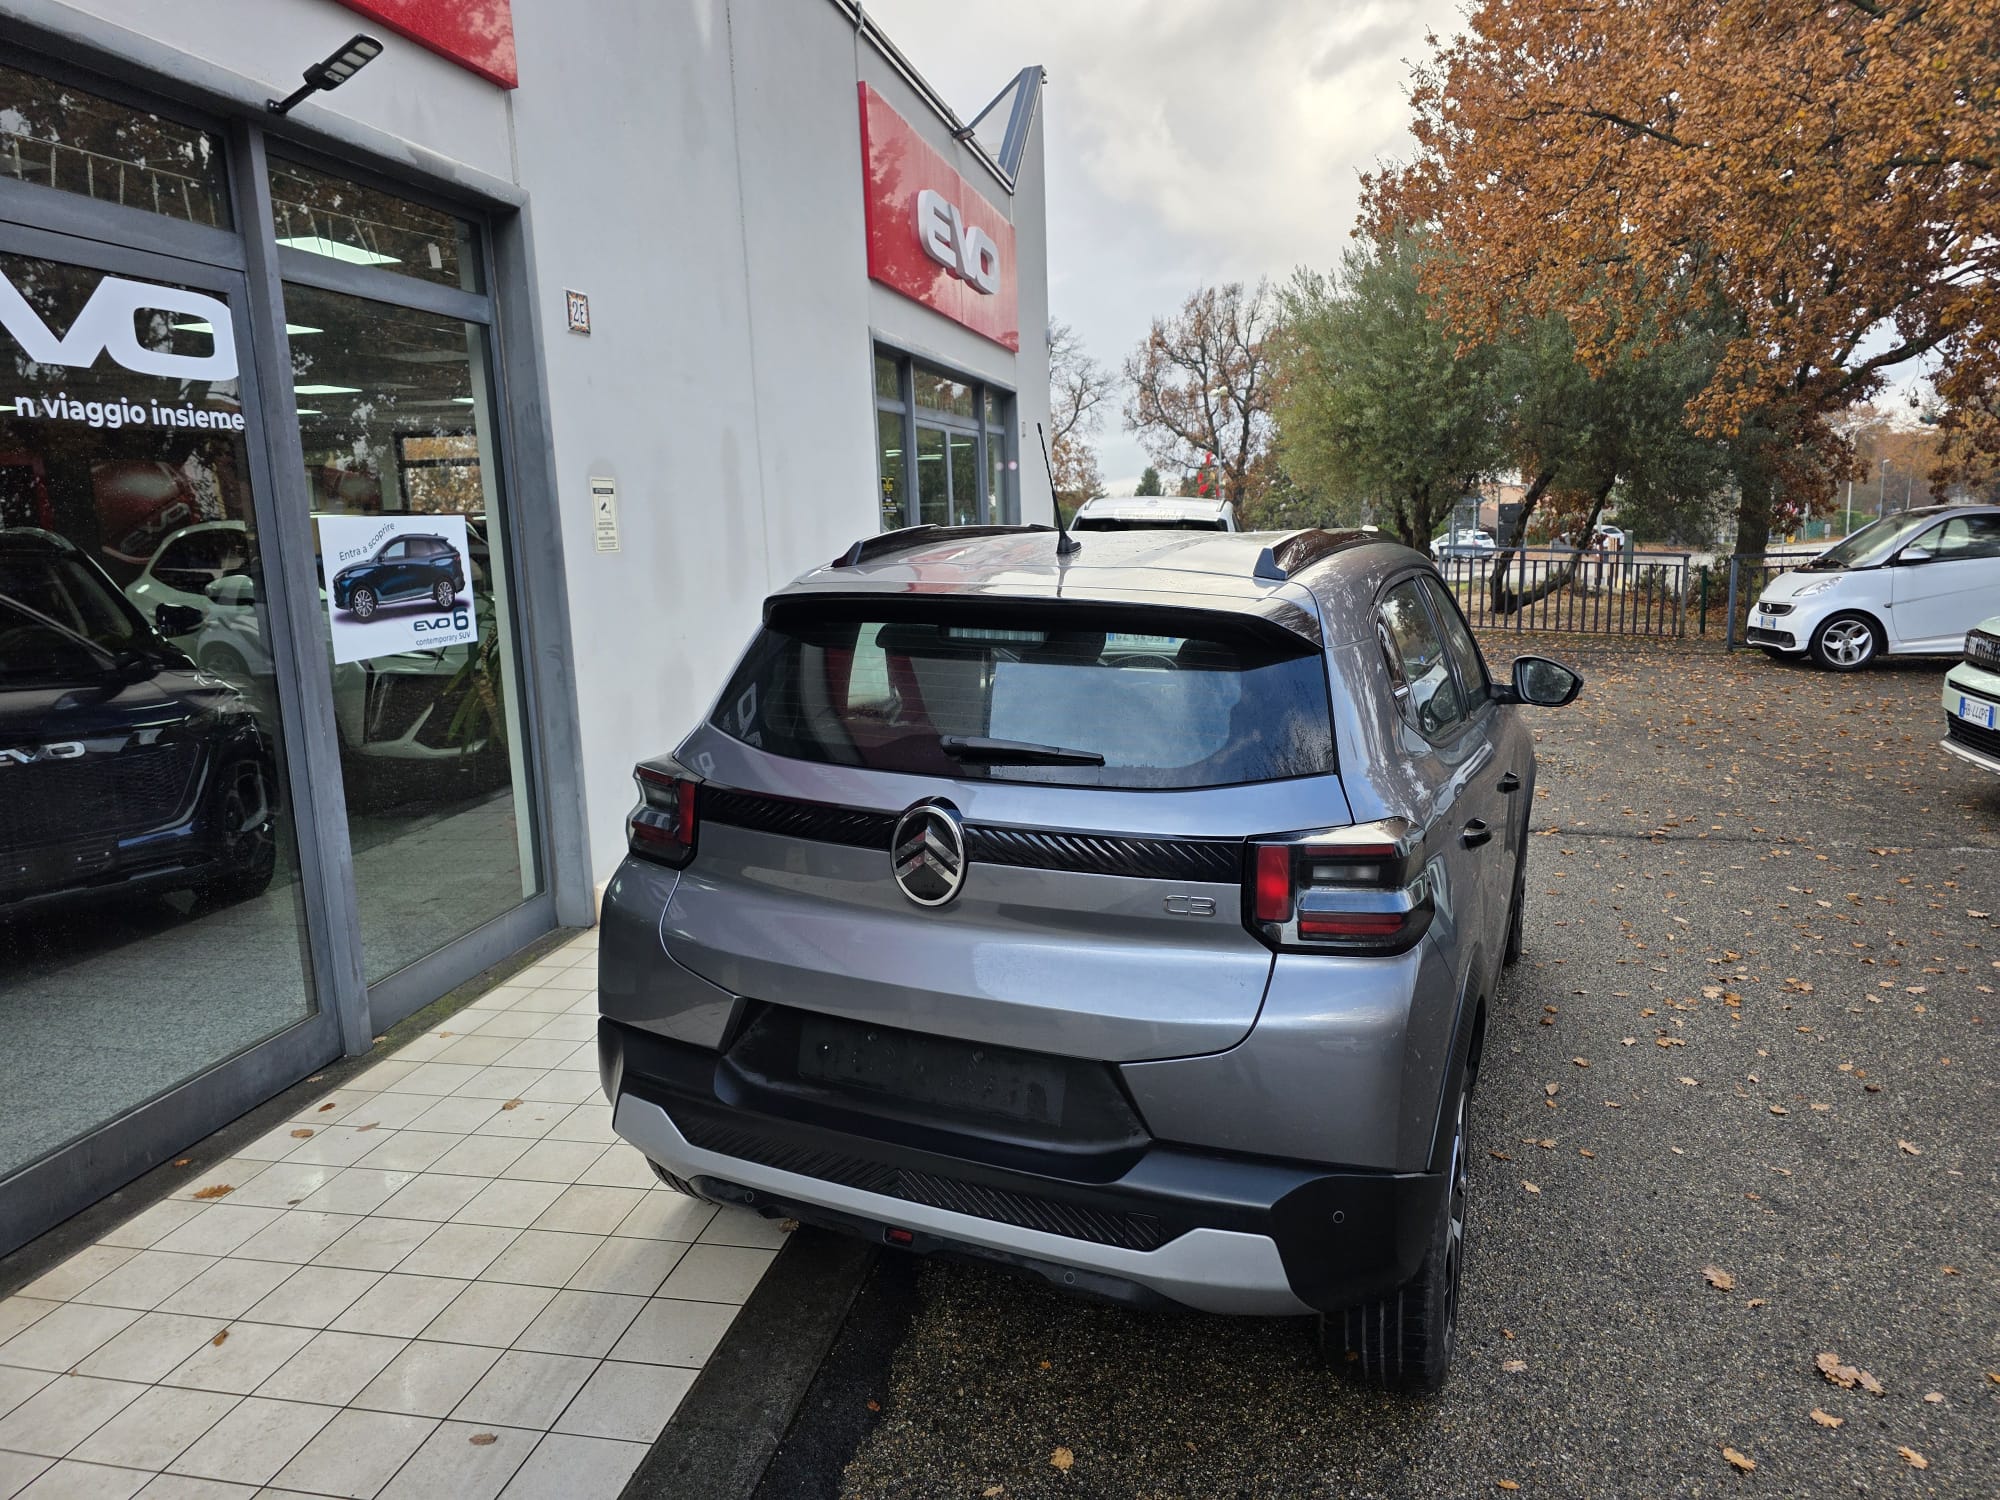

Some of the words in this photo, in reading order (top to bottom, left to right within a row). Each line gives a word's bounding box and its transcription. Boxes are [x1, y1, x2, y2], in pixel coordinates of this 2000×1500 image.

[917, 189, 998, 295] EVO
[0, 269, 239, 382] VO
[42, 392, 146, 429] viaggio
[151, 399, 245, 431] insieme
[339, 548, 361, 561] Entra
[368, 522, 395, 549] scoprire
[415, 633, 458, 646] contemporary
[458, 630, 471, 640] SUV
[1163, 894, 1216, 917] C3
